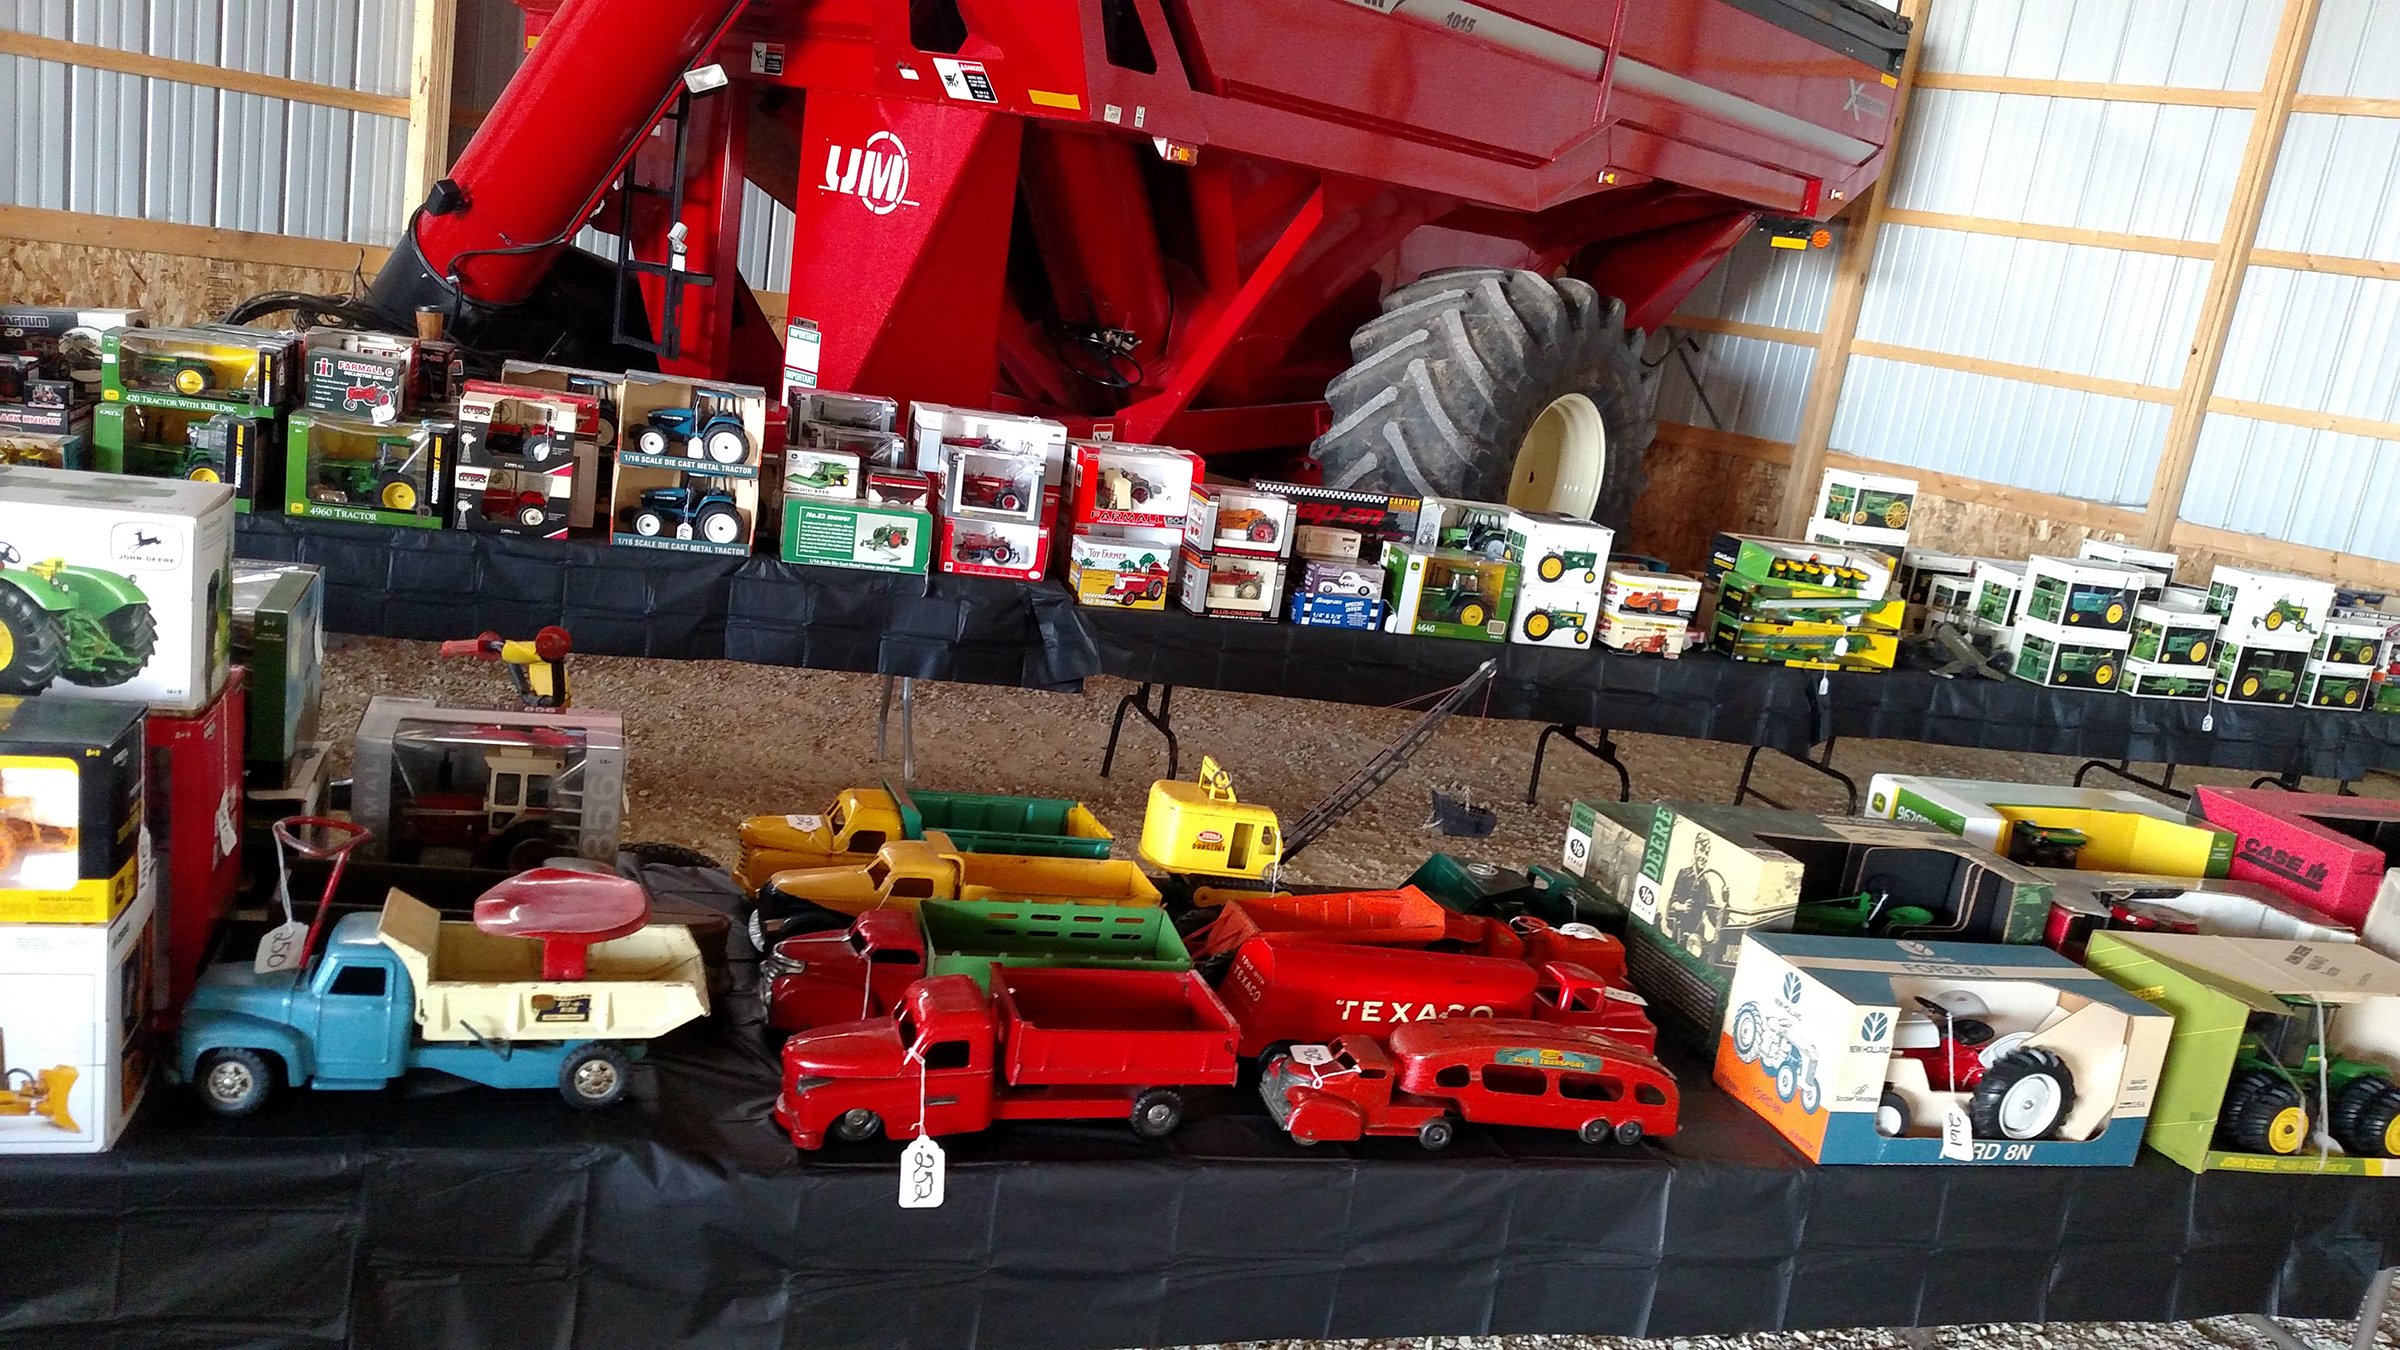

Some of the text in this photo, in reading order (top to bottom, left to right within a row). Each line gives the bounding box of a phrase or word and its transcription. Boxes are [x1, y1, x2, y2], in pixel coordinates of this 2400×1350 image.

[1446, 11, 1477, 34] 1015
[0, 315, 50, 328] AGNUM
[337, 360, 395, 378] FARMALL C
[125, 394, 238, 413] 420 TRACTOR WITH KBL DISC
[624, 454, 753, 475] 1/16 SCALE DIE CAST METAL TRACTOR
[1388, 496, 1420, 508] CAUTION
[310, 507, 377, 521] 4960 TRACTOR
[1090, 510, 1164, 524] FARMALL
[1166, 516, 1187, 525] 504
[617, 537, 745, 556] 1/16 SCALE DIE CAST METAL TRACTOR
[1082, 592, 1124, 601] International
[1315, 597, 1343, 605] Snap-on
[1416, 623, 1436, 633] 4640
[1642, 806, 1674, 881] DEERE
[2244, 837, 2305, 873] CASE
[266, 930, 296, 968] 250
[1901, 963, 2000, 976] FORD 8N
[1233, 964, 1262, 1002] TEXACO
[1849, 1045, 1890, 1054] NEW HOLLAND
[1512, 1056, 1535, 1064] AUTO
[1855, 1095, 1879, 1103] Models
[1948, 1112, 1963, 1147] 261
[2003, 1144, 2036, 1161] 8N
[2220, 1156, 2247, 1168] JOHN
[2246, 1158, 2277, 1170] DEERE
[912, 1151, 936, 1203] 252
